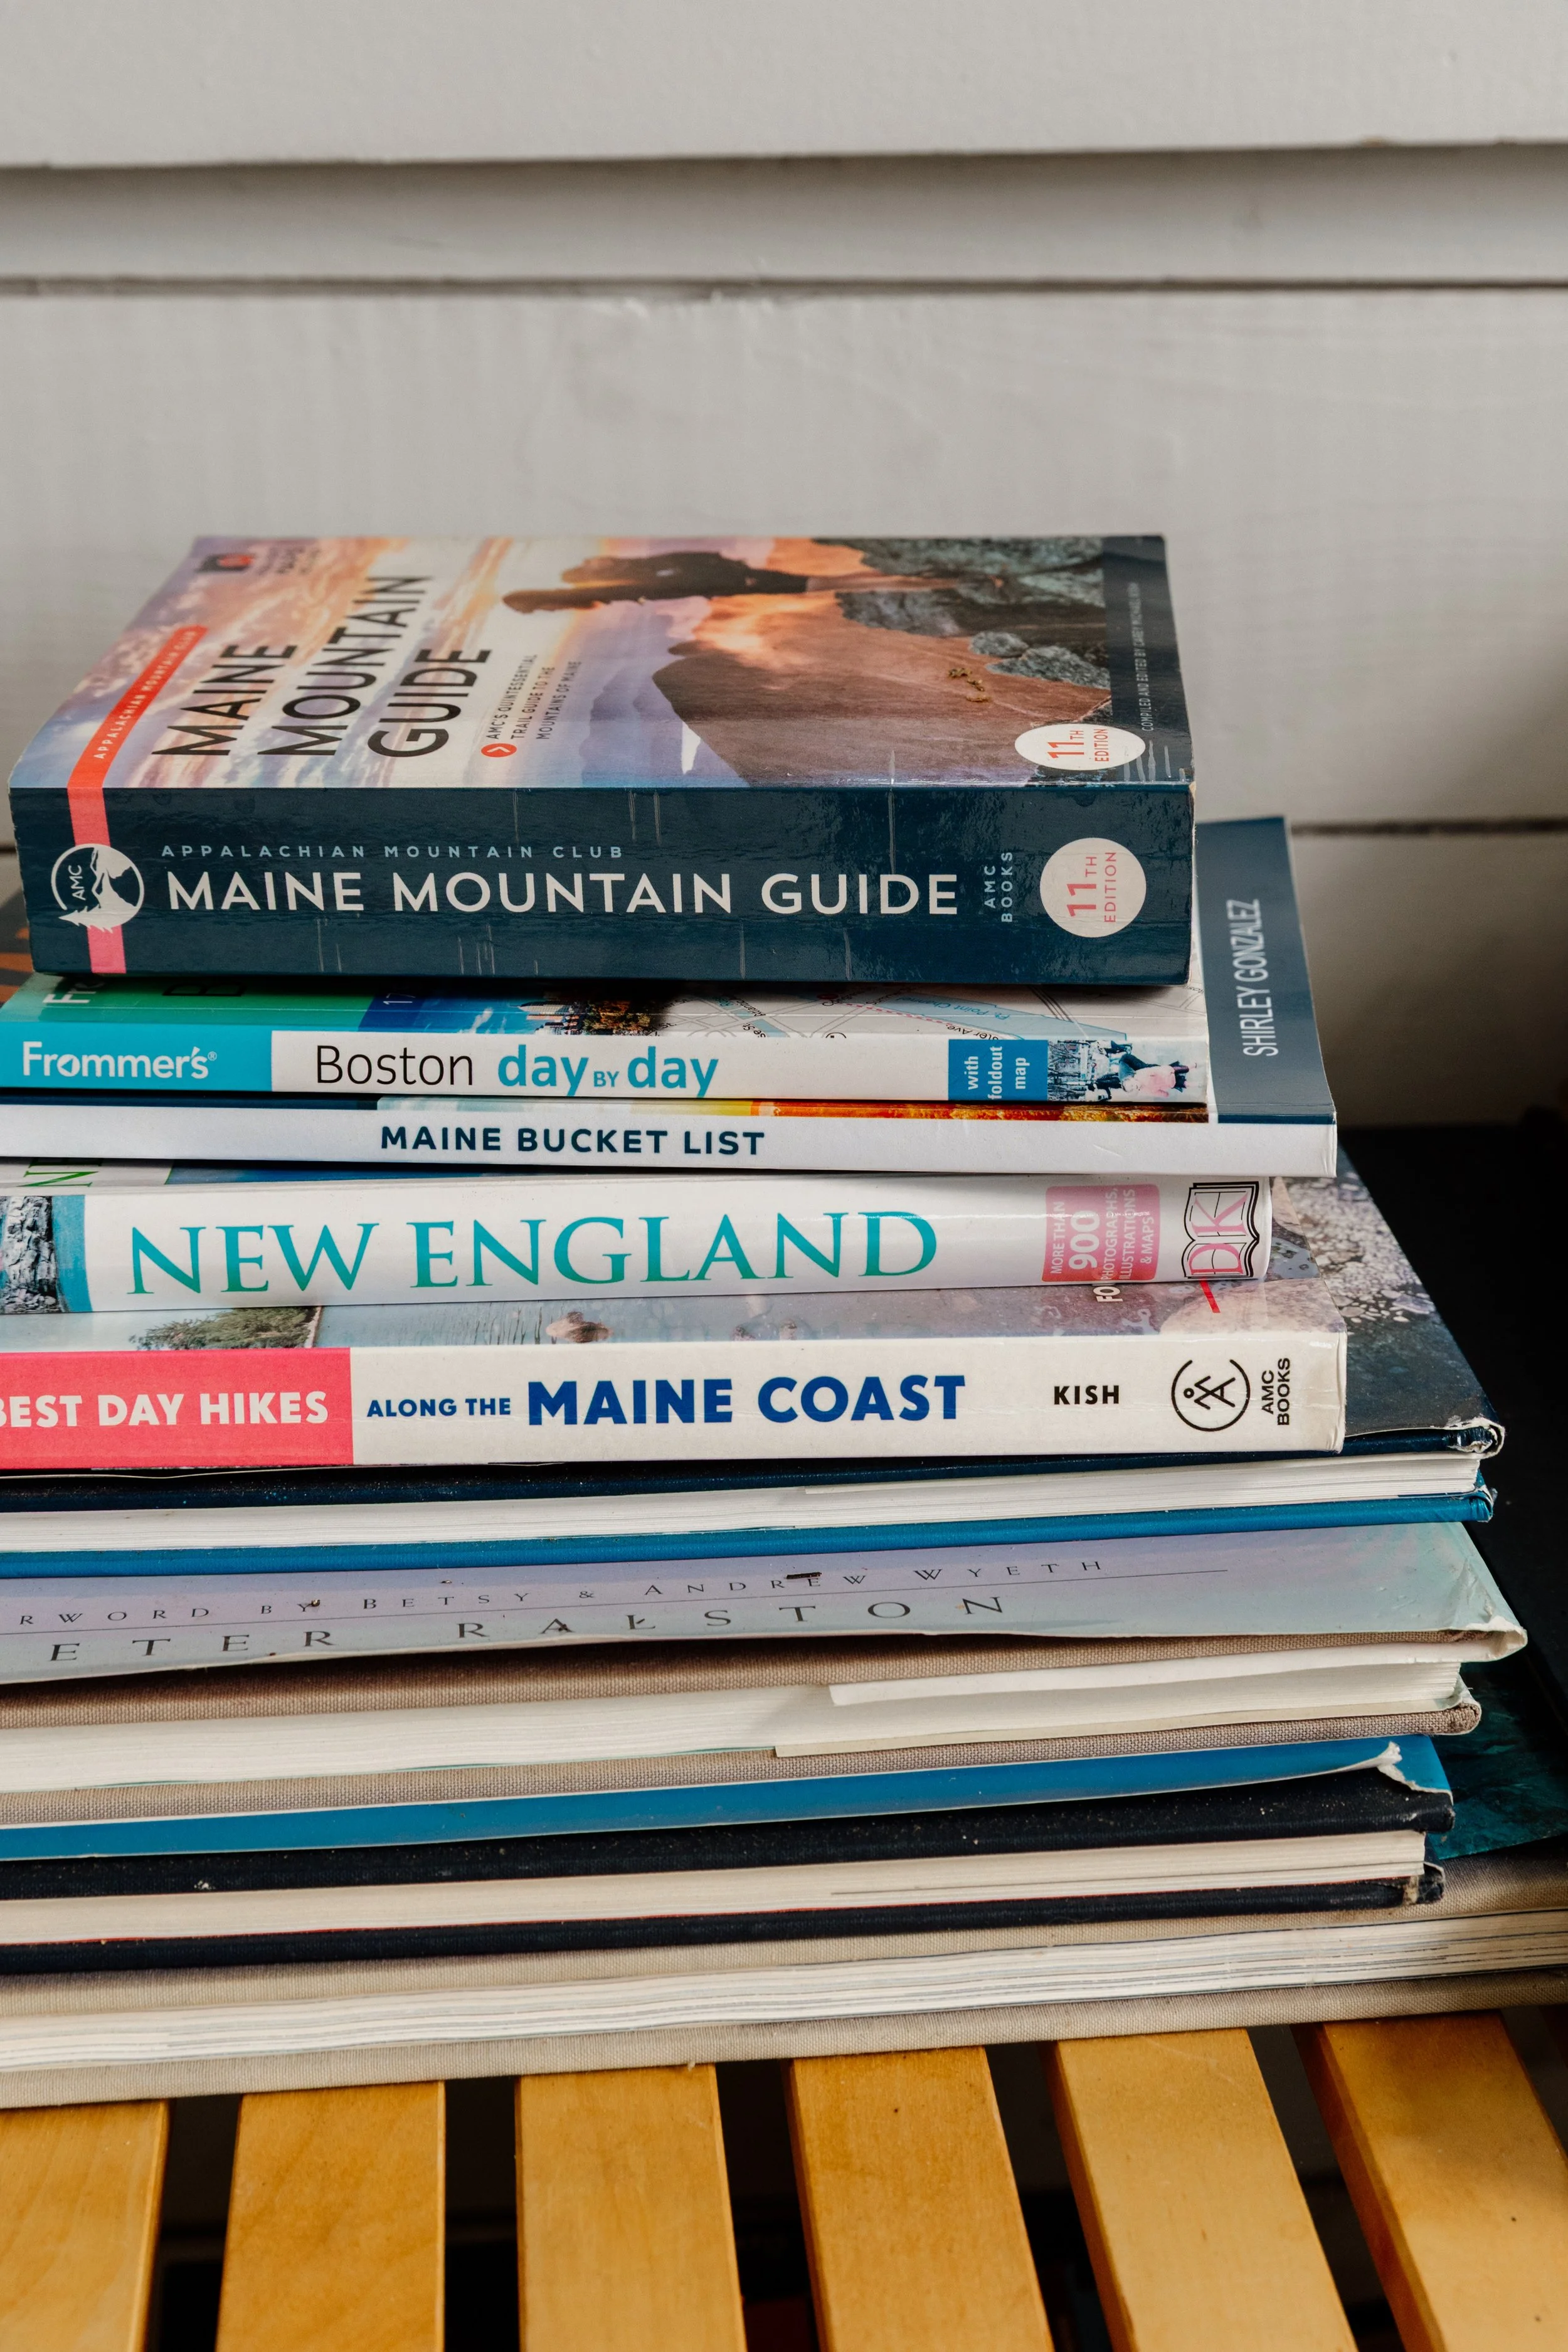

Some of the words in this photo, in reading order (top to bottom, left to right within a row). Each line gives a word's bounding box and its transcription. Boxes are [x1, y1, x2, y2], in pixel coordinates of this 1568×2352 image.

[257, 576, 433, 756] MOUNTAIN
[561, 662, 581, 681] MAINE
[1134, 649, 1145, 657] BY
[1135, 659, 1148, 682] EDITED
[532, 681, 548, 690] TO
[538, 667, 555, 679] THE
[556, 684, 570, 692] OF
[1137, 684, 1150, 696] AND
[152, 645, 297, 756] MAINE
[368, 649, 490, 758] GUIDE
[486, 714, 508, 739] AMC'S
[497, 654, 538, 712] QUINTESSENTIAL
[522, 692, 543, 714] GUIDE
[1138, 698, 1153, 731] COMPILED
[511, 716, 532, 739] TRAIL
[536, 694, 566, 739] MOUNTAINS
[1094, 728, 1109, 762] EDITION
[162, 845, 364, 858] APPALACHIAN
[384, 846, 532, 859] MOUNTAIN
[553, 846, 623, 859] CLUB
[71, 865, 84, 901] AMC
[167, 871, 364, 910] MAINE
[394, 872, 731, 913] MOUNTAIN
[761, 873, 957, 914] GUIDE
[984, 864, 996, 909] AMC
[1002, 851, 1013, 923] BOOKS
[1104, 851, 1116, 923] EDITION
[1227, 899, 1269, 982] GONZALEZ
[736, 1000, 766, 1017] Atlantic
[896, 996, 951, 1009] Channel
[954, 1005, 988, 1015] Point
[1237, 985, 1279, 1056] SHIRLEY
[945, 1024, 972, 1035] Ave.
[317, 1046, 473, 1086] Boston
[498, 1045, 589, 1096] day
[593, 1071, 619, 1088] BY
[628, 1046, 719, 1098] day
[965, 1055, 978, 1090] with
[988, 1046, 1002, 1099] foldout
[1015, 1057, 1030, 1089] map
[381, 1126, 501, 1150] MAINE
[518, 1129, 667, 1153] BUCKET
[684, 1131, 764, 1155] LIST
[1053, 1201, 1065, 1239] THAN
[1101, 1189, 1118, 1280] PHOTOGRAPHS,
[1119, 1189, 1135, 1279] ILLUSTRATIONS
[1141, 1217, 1154, 1254] MAPS
[1188, 1192, 1249, 1275] DK
[127, 1223, 379, 1294] NEW
[406, 1212, 936, 1288] ENGLAND
[1068, 1210, 1100, 1269] 900
[1050, 1243, 1064, 1274] MORE
[1092, 1283, 1123, 1302] FO
[98, 1394, 184, 1426] DAY
[200, 1391, 329, 1425] HIKES
[368, 1399, 457, 1417] ALONG
[467, 1397, 511, 1415] THE
[528, 1379, 733, 1426] MAINE
[758, 1375, 965, 1424] COAST
[1054, 1385, 1119, 1406] KISH
[1261, 1370, 1274, 1415] AMC
[1278, 1357, 1290, 1426] BOOKS
[261, 1604, 311, 1616] BY
[364, 1592, 529, 1610] BETSY
[580, 1591, 595, 1599] &
[644, 1574, 866, 1596] ANDREW
[914, 1561, 1101, 1581] WYETH
[50, 1631, 336, 1661] ETER
[457, 1597, 1004, 1639] RALSTON
